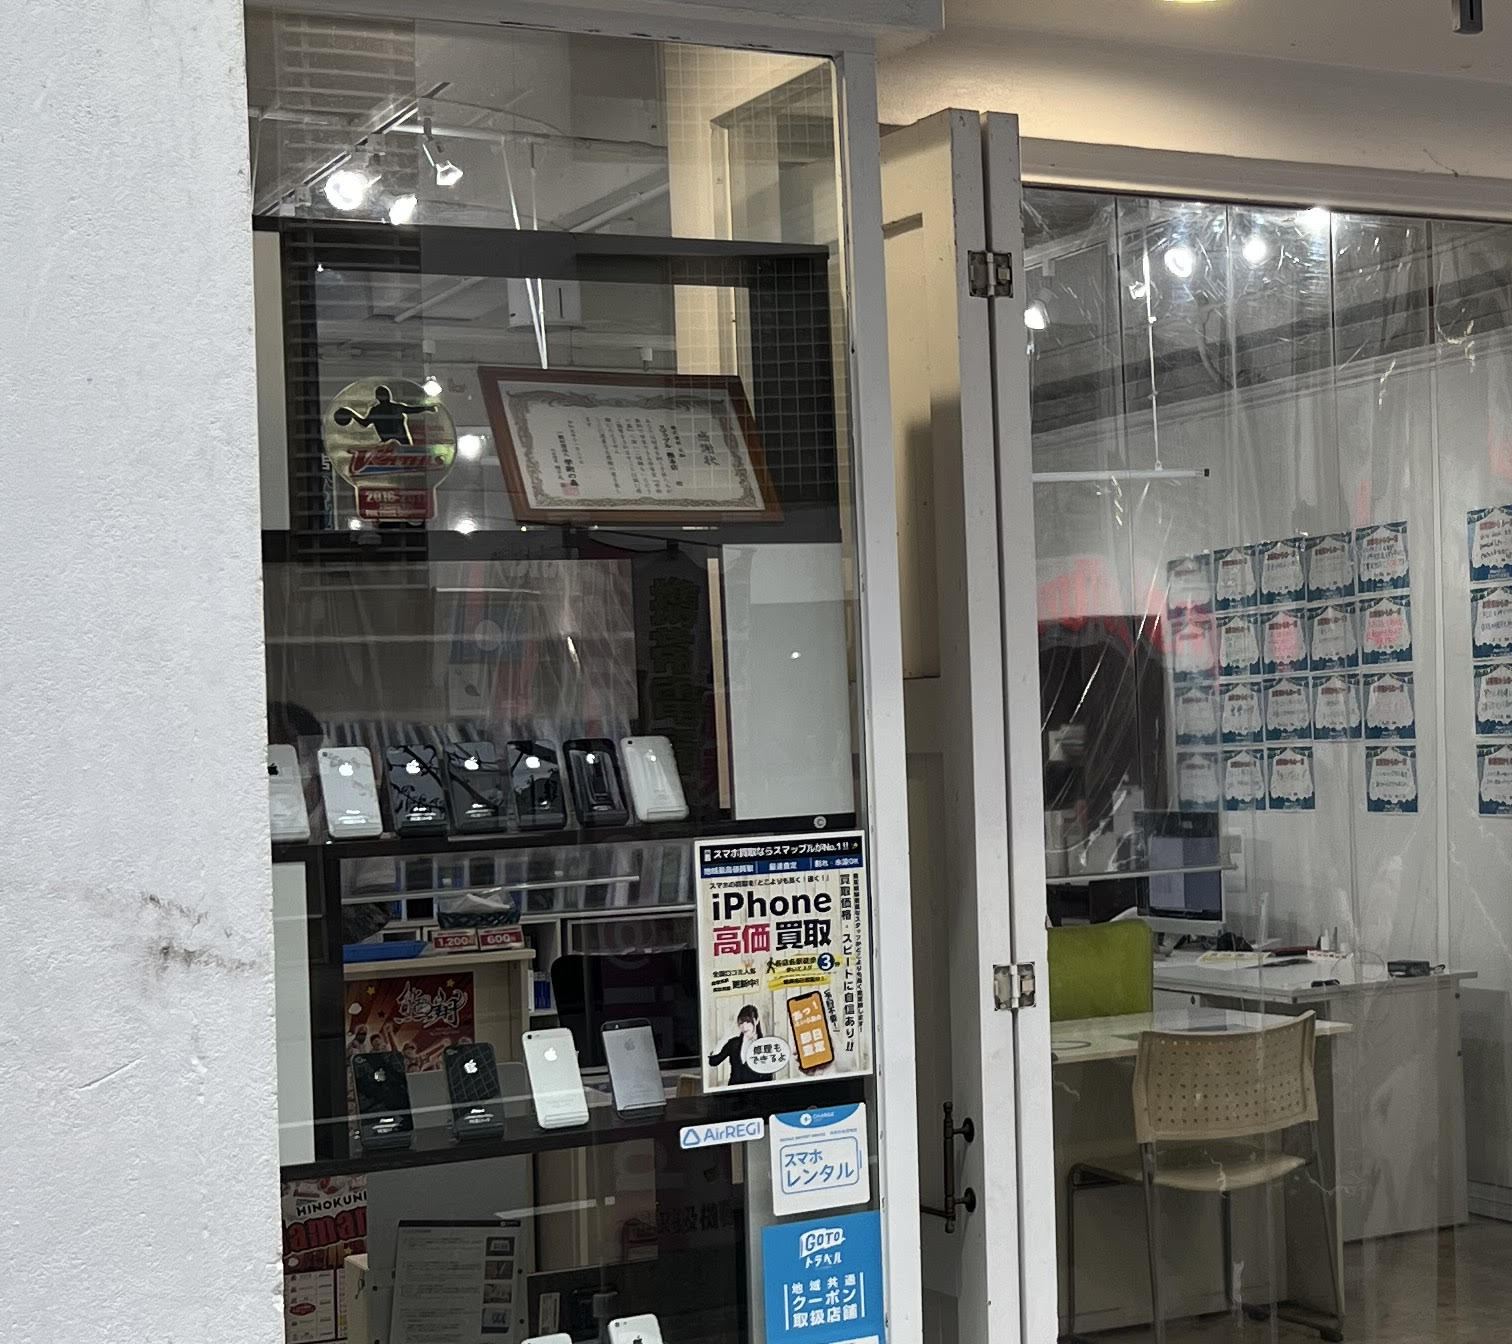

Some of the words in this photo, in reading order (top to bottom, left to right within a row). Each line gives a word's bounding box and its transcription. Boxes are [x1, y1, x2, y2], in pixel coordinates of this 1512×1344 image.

[712, 891, 832, 921] iPhone
[713, 919, 832, 957] 高価買取
[821, 954, 832, 970] 3
[749, 1053, 786, 1065] できるよ
[703, 1122, 761, 1143] AirREGI
[784, 1148, 823, 1168] スマホ
[786, 1161, 855, 1188] レンタル
[296, 1190, 367, 1218] HINOKUNI
[805, 1251, 843, 1269] トラベル
[792, 1272, 857, 1295] 地域共通
[793, 1288, 858, 1313] クーポン
[793, 1306, 858, 1329] 取扱店舗
